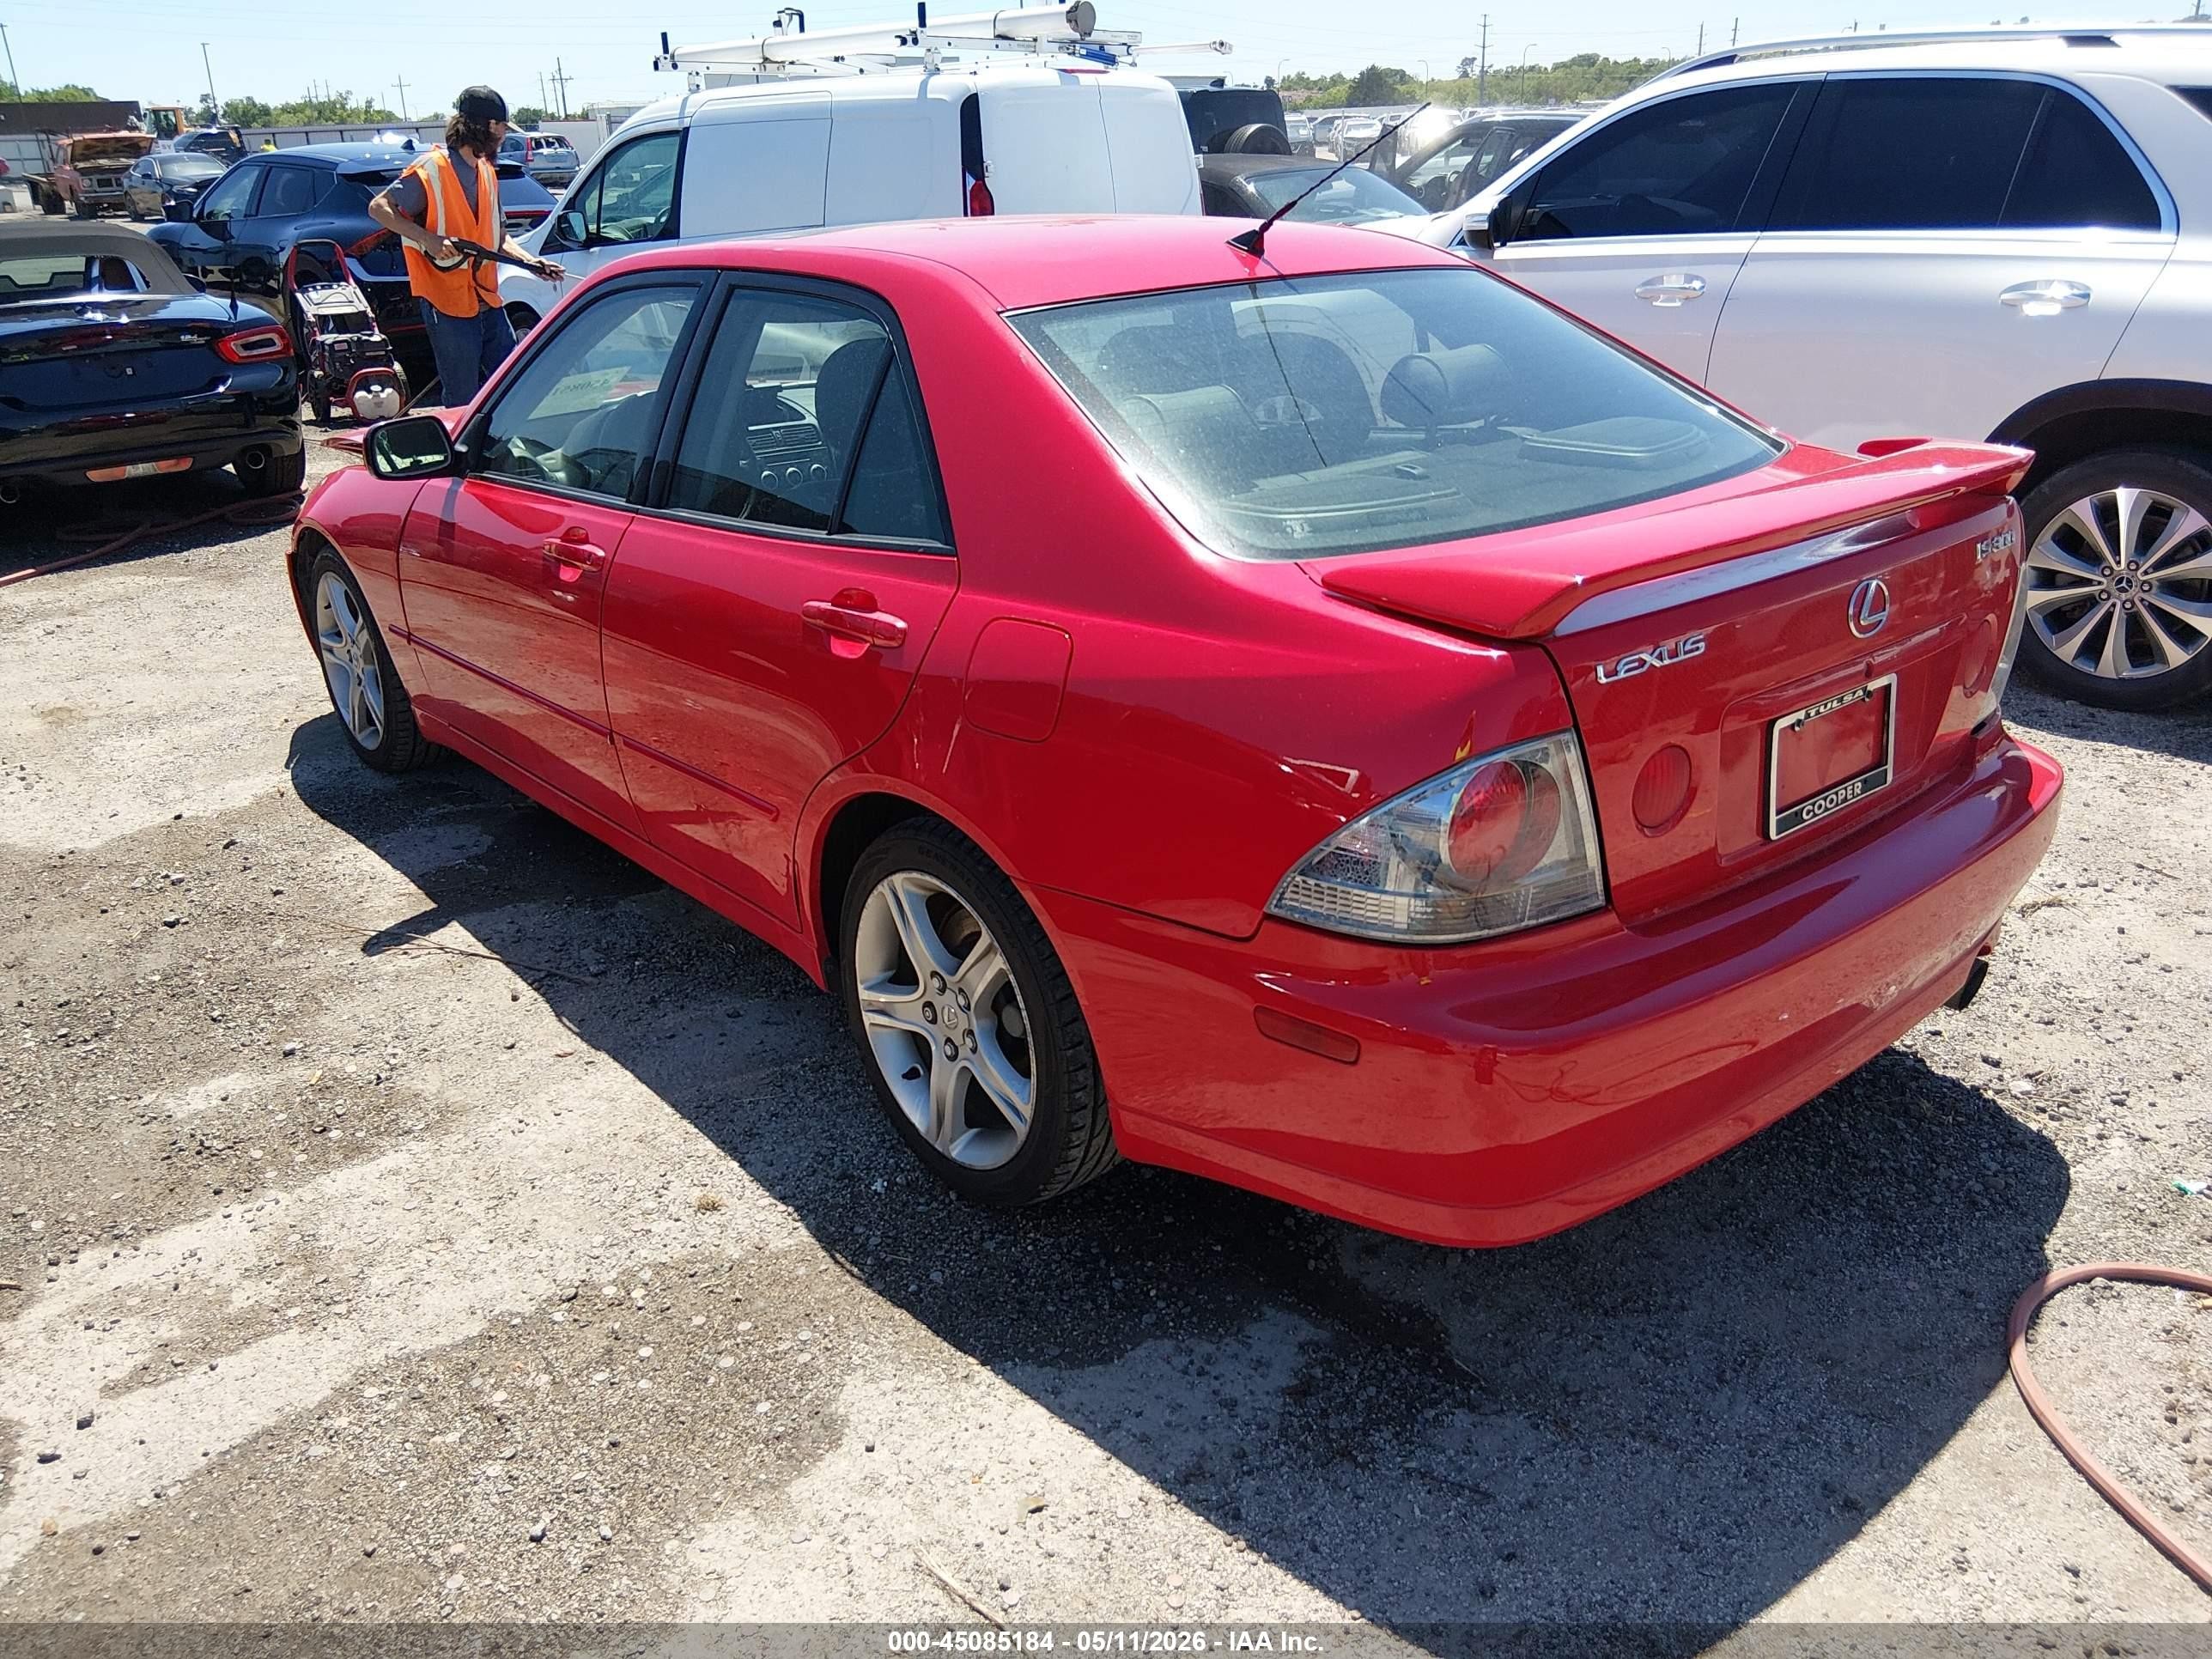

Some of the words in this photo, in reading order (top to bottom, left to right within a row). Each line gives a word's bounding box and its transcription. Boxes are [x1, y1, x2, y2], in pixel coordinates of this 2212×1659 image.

[1595, 633, 1705, 684] LEXUS
[1808, 689, 1865, 717] TULSA
[1802, 781, 1863, 821] COOPER
